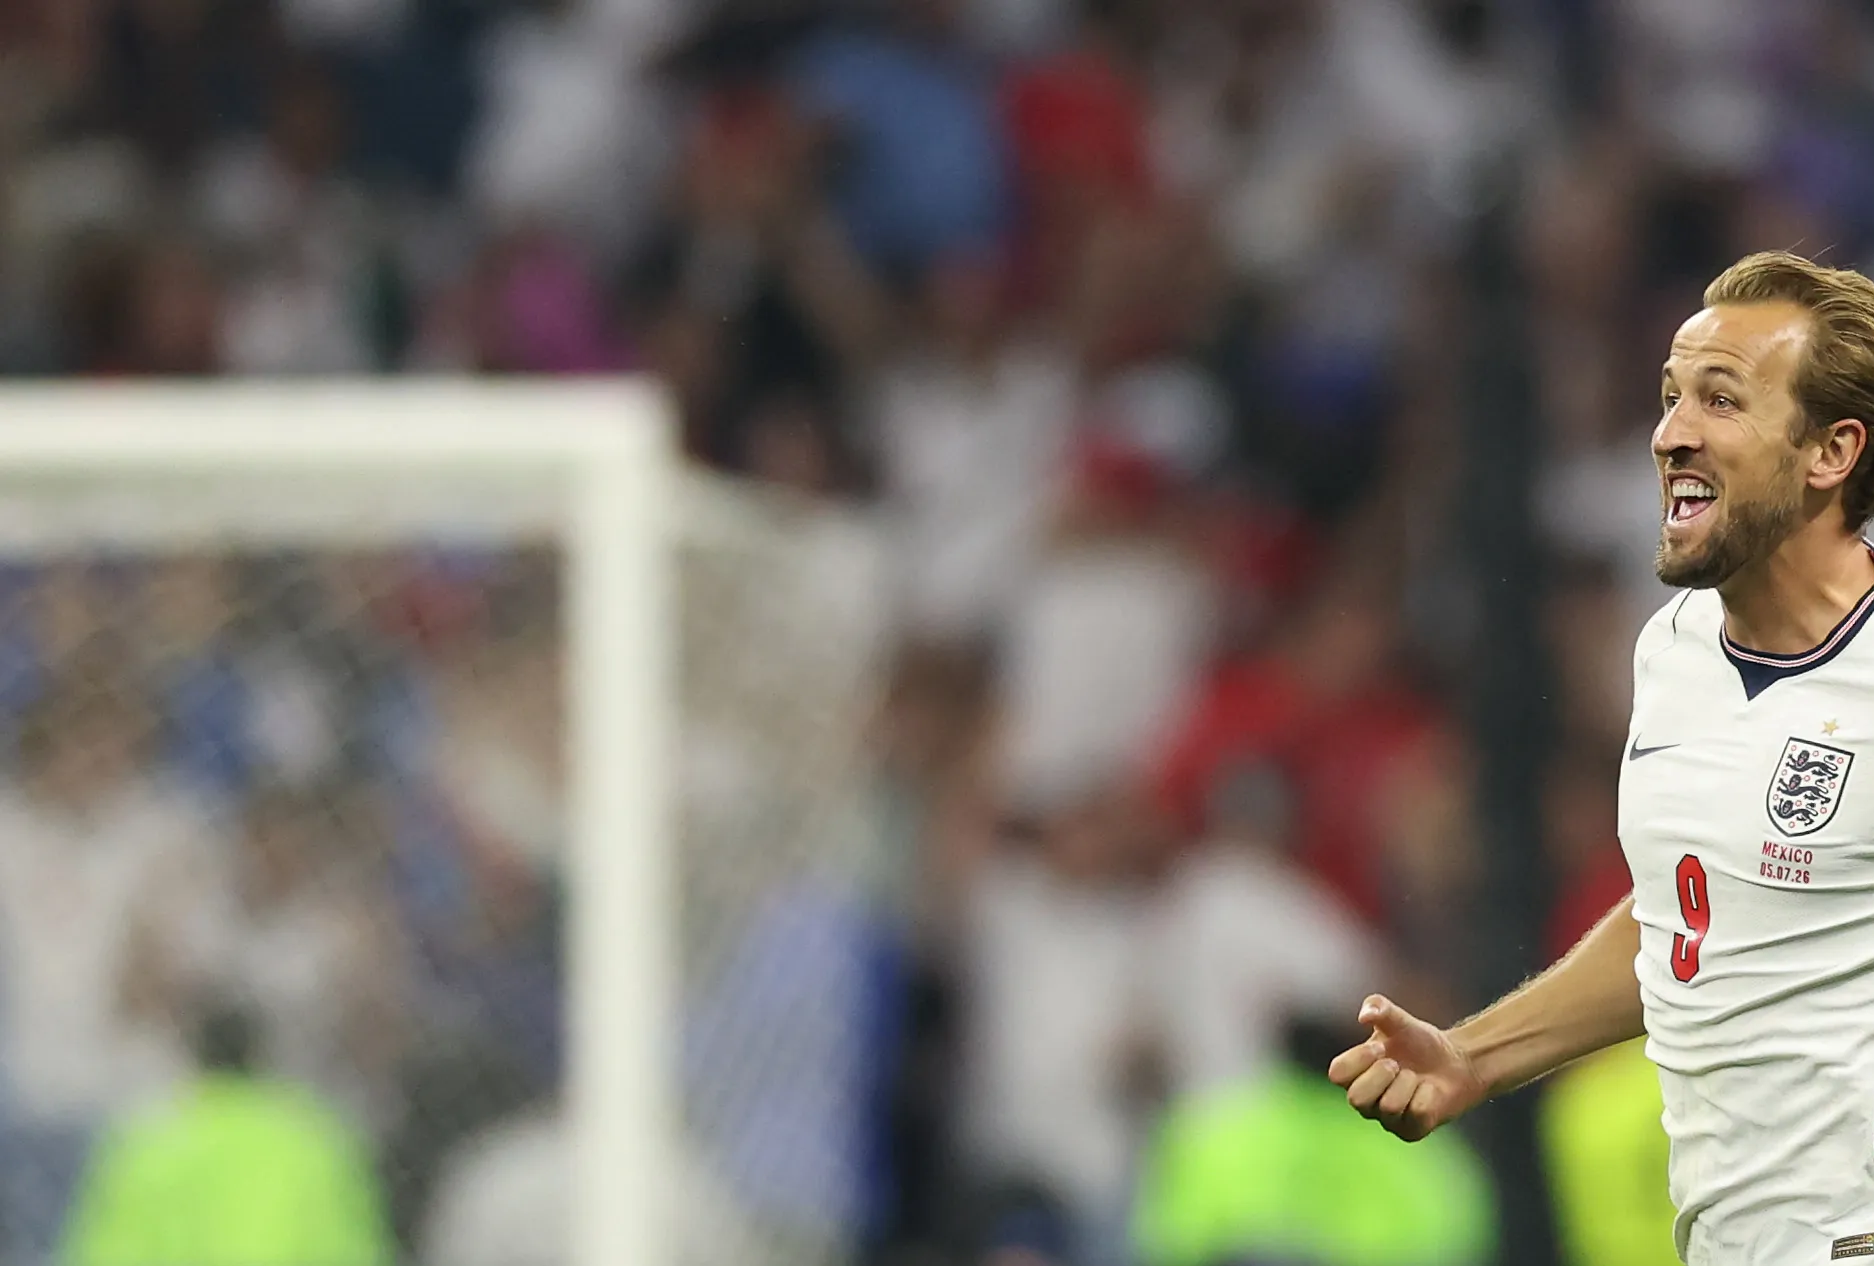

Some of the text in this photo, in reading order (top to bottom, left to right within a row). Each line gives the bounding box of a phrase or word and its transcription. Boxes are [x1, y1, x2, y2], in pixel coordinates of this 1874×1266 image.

[1762, 841, 1813, 865] MEXICO
[1760, 862, 1810, 884] 05.07.26
[1670, 853, 1710, 983] 9
